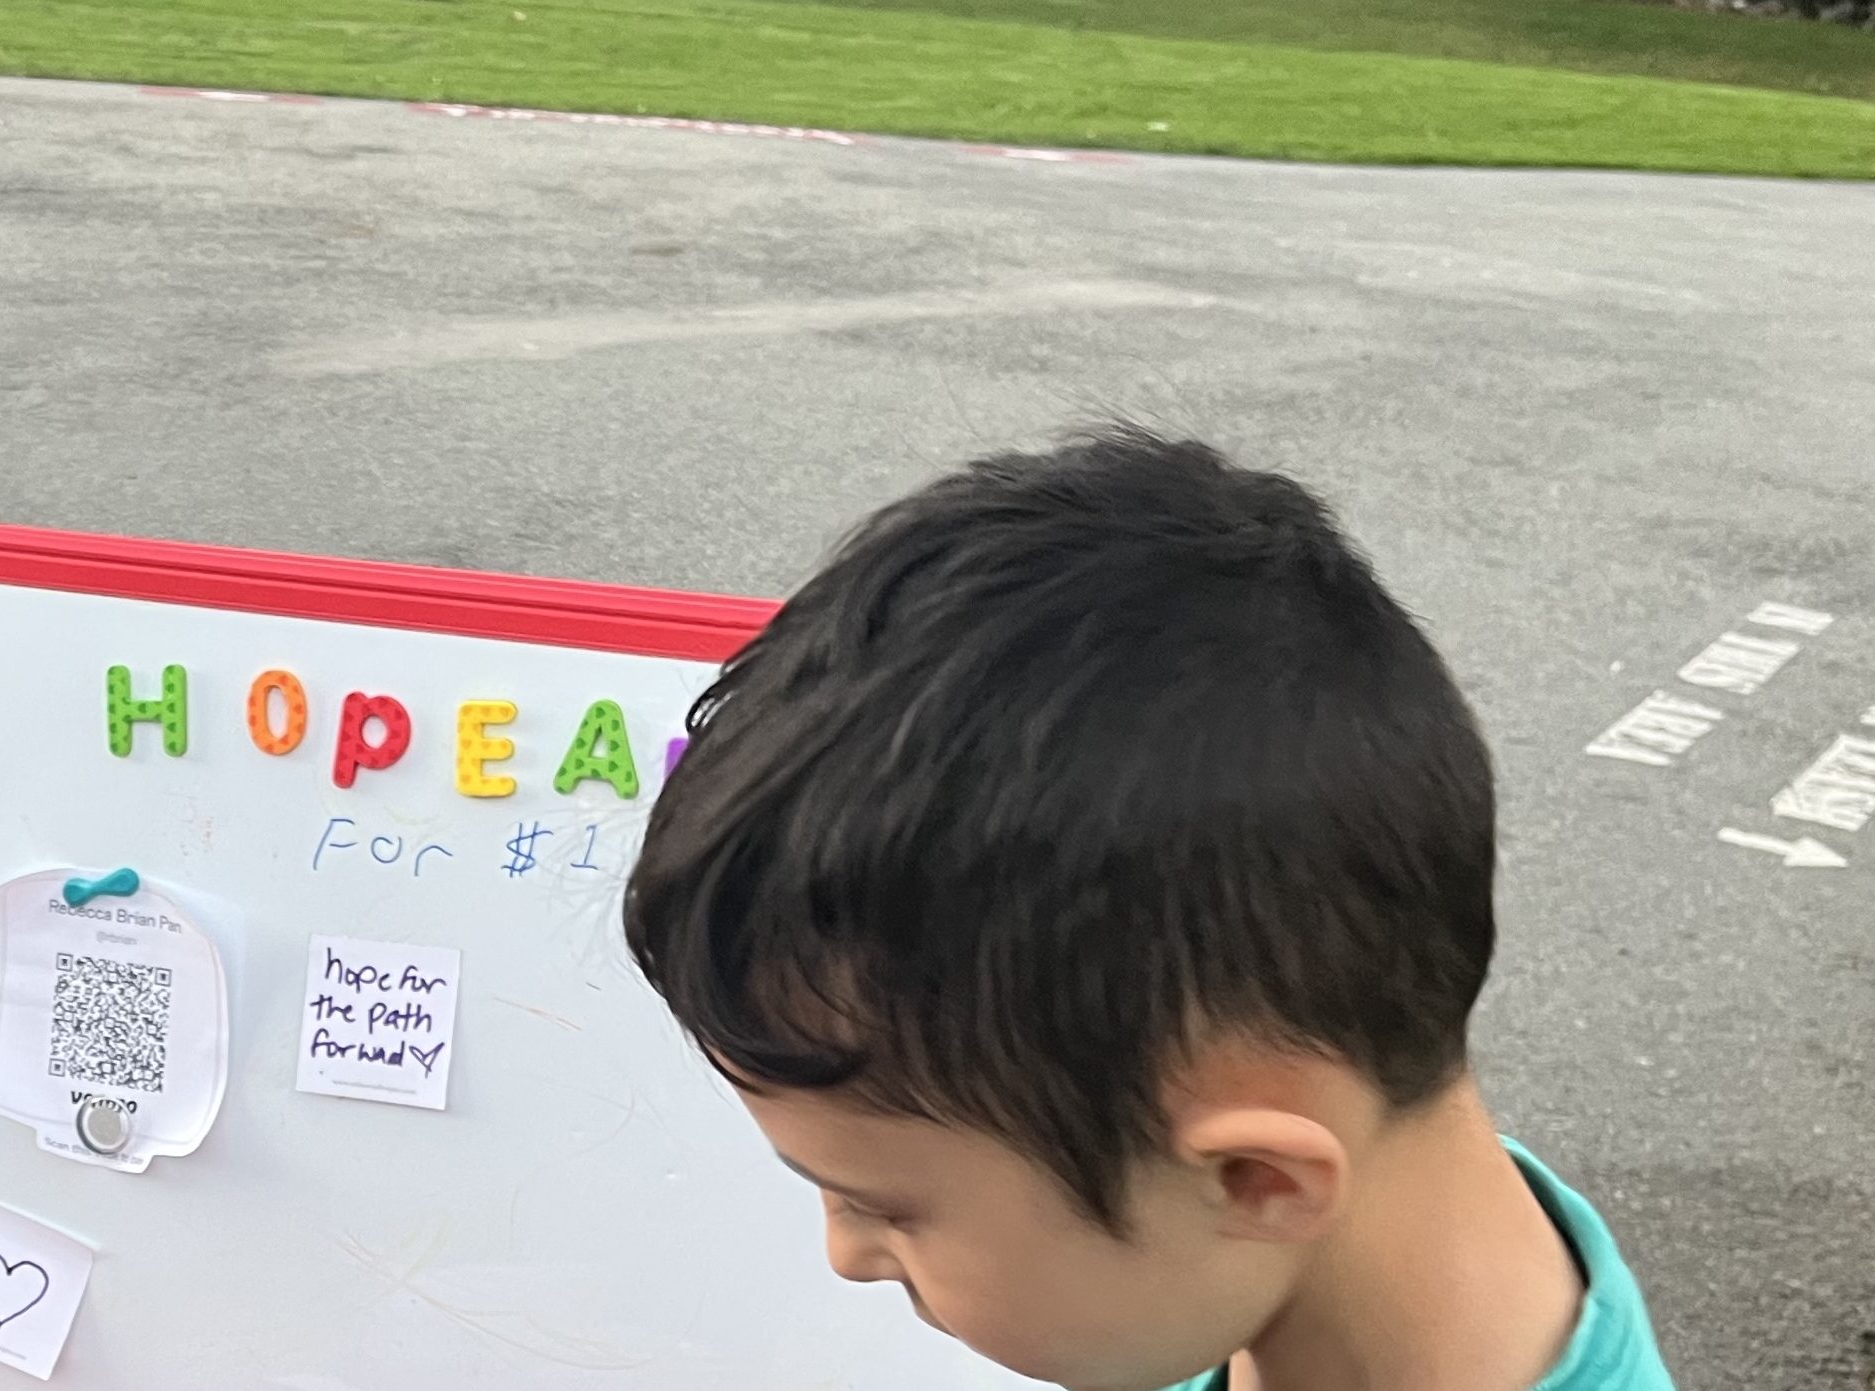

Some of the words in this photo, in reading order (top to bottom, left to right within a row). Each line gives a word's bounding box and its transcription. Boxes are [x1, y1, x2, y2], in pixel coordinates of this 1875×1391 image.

[313, 818, 453, 877] For
[48, 899, 112, 922] Rebecca
[117, 909, 156, 928] Brian
[160, 915, 182, 934] Pan
[325, 947, 392, 993] hope
[309, 994, 356, 1023] the
